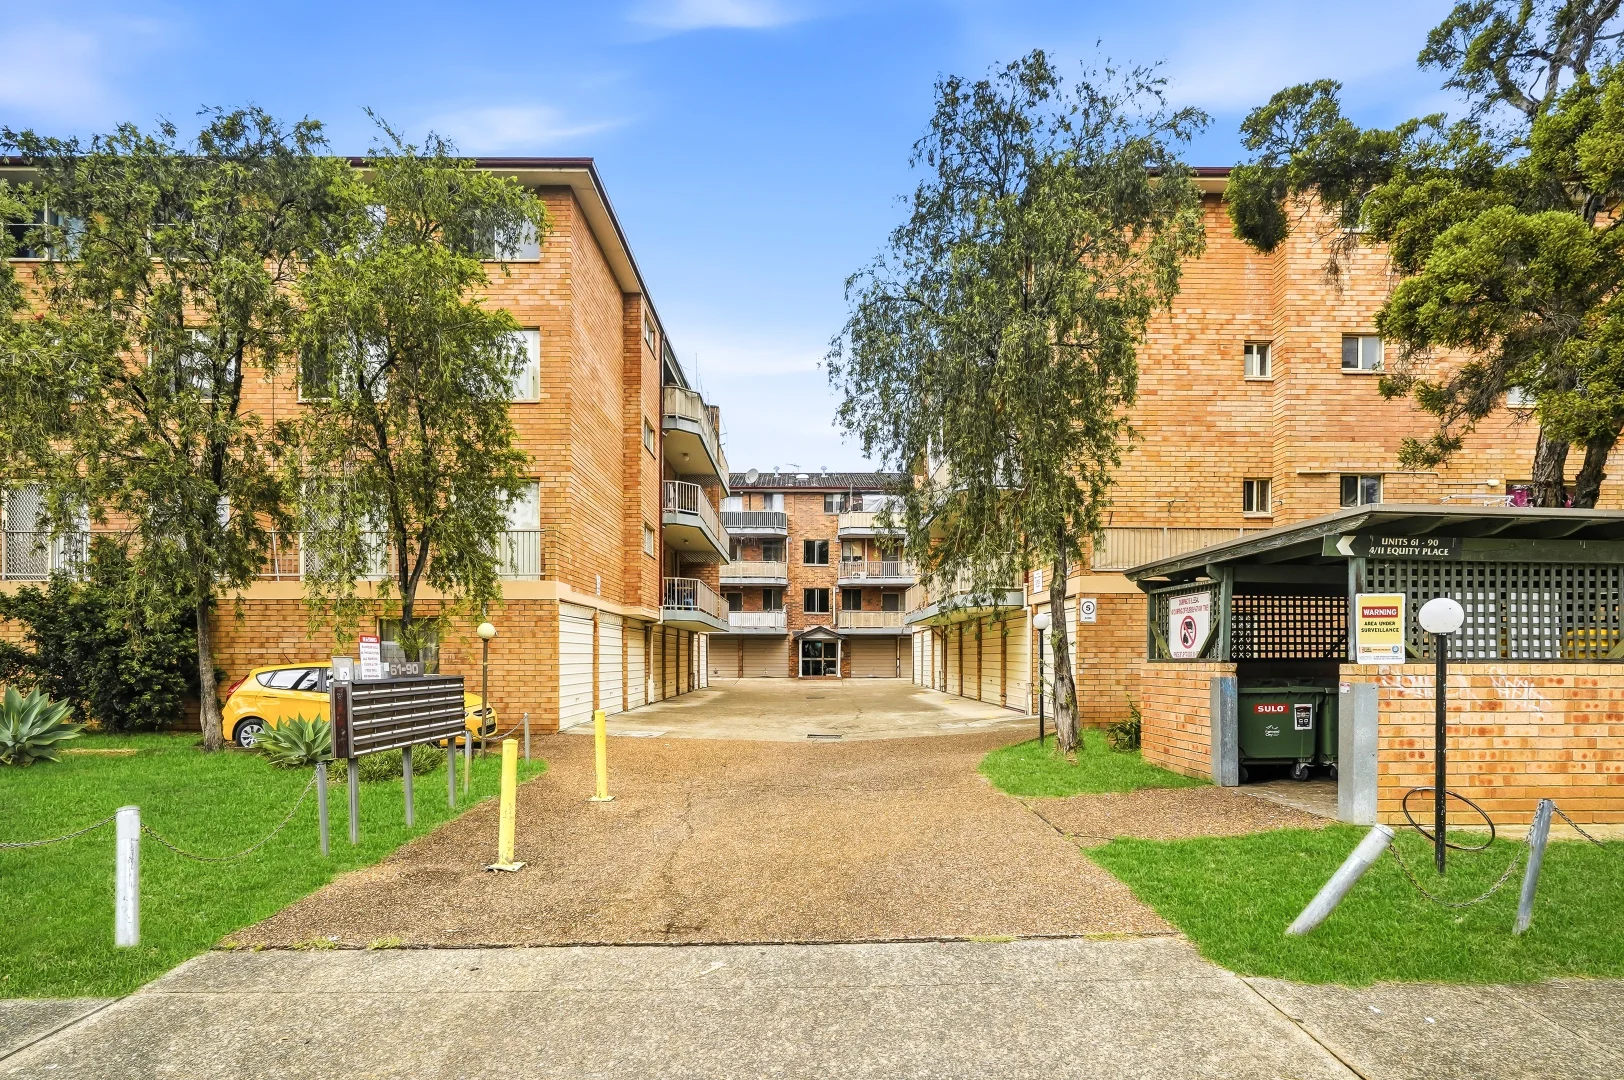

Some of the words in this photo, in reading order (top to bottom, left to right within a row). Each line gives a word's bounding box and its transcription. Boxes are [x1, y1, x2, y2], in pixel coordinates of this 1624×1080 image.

[1381, 537, 1408, 546] UNITS
[1410, 538, 1419, 546] 61
[1427, 539, 1439, 547] 90
[1386, 547, 1420, 556] EQUITY
[1422, 548, 1450, 556] PLACE
[1085, 604, 1091, 612] 5
[1363, 608, 1397, 616] WARNING
[390, 663, 419, 676] 61-90
[1257, 705, 1284, 713] SULO
